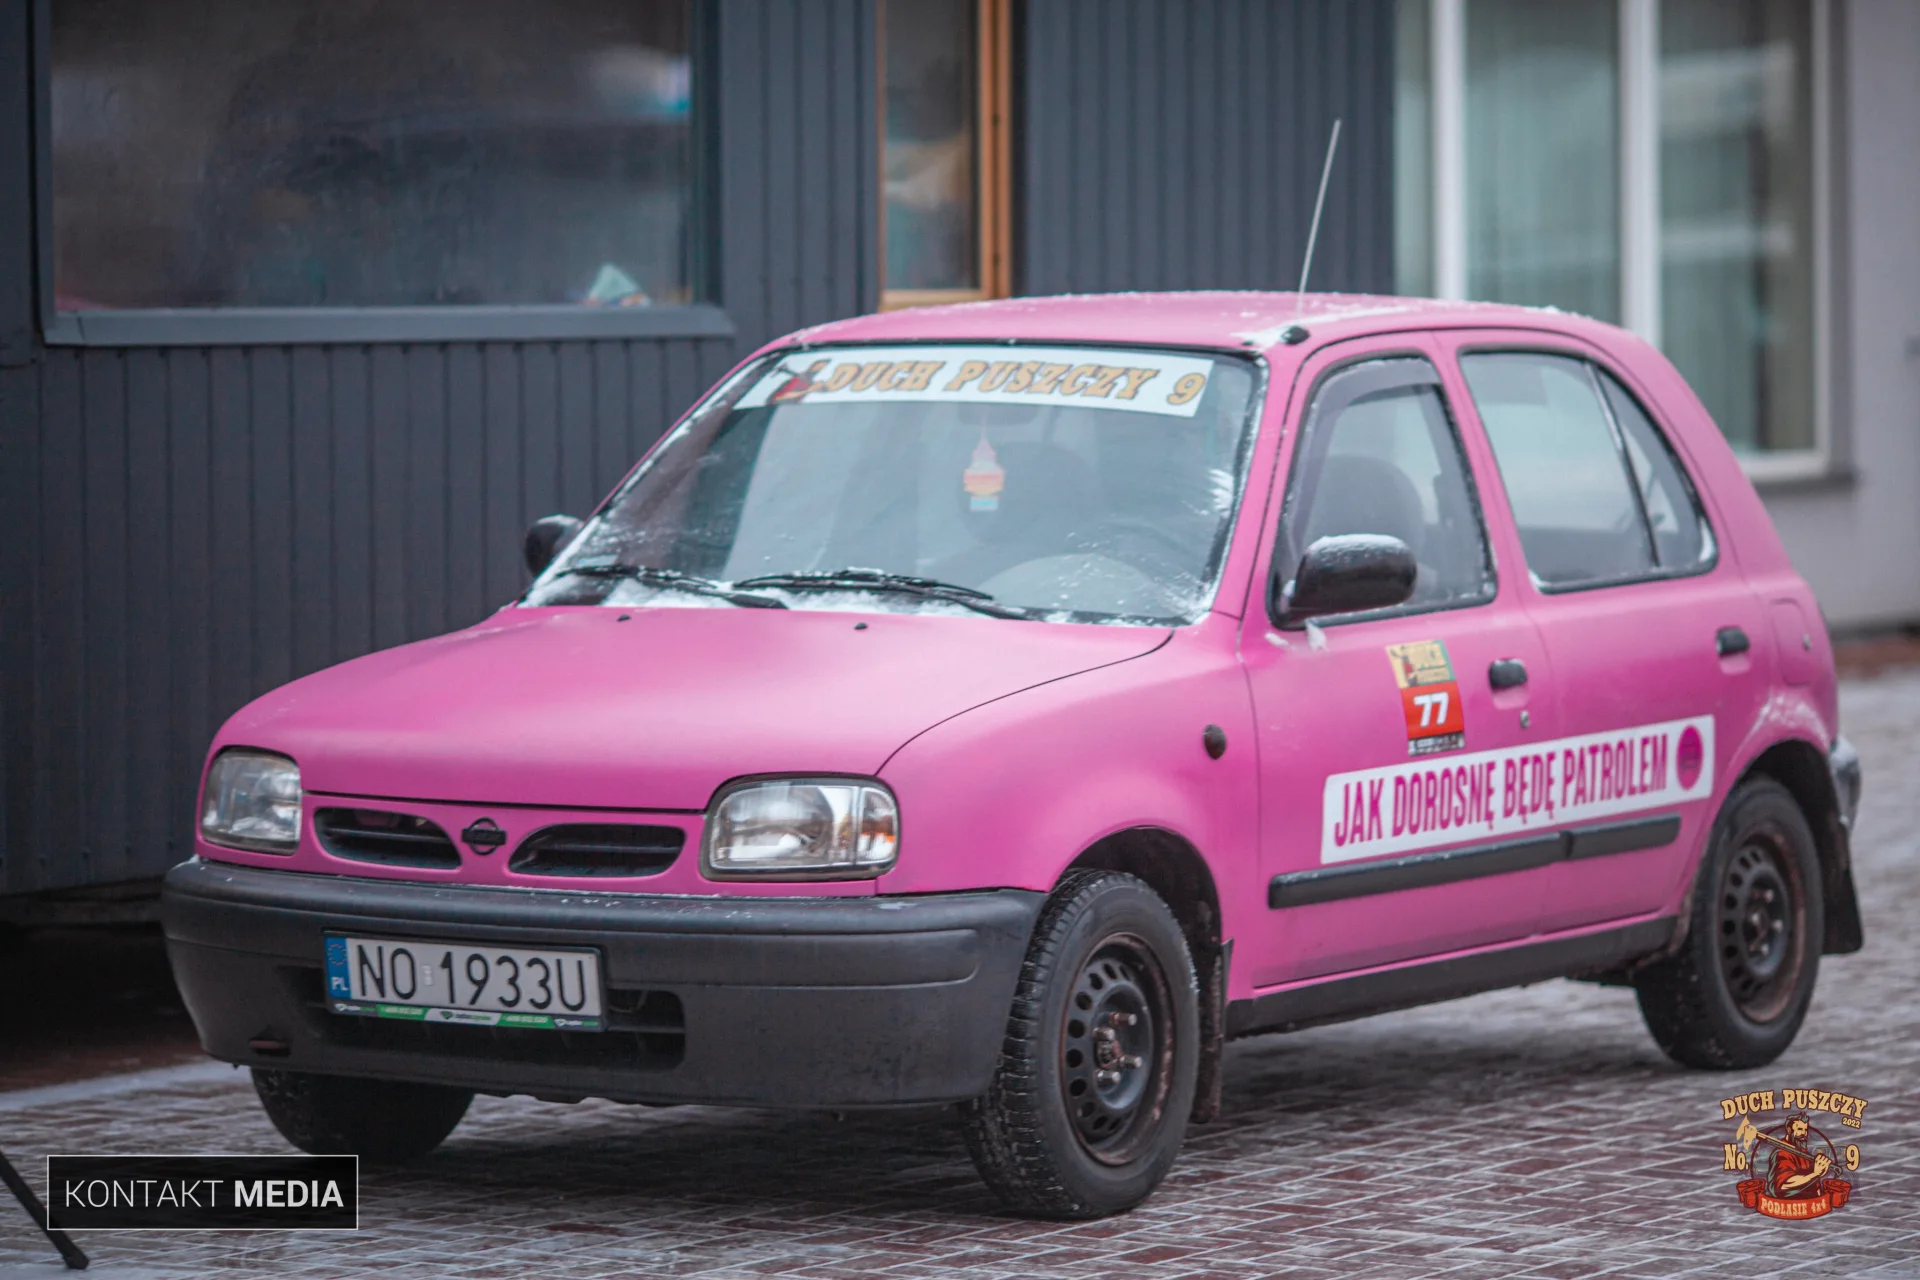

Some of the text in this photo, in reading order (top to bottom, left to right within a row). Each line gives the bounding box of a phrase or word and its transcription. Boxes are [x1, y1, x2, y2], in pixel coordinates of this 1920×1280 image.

[828, 360, 1207, 406] DUCH PUSZCZY 9
[1413, 691, 1450, 728] 77
[1334, 732, 1669, 848] JAK DOROSNĘ BĘDĘ PATROLEM
[331, 976, 349, 991] PL
[357, 944, 587, 1012] NO 1933U
